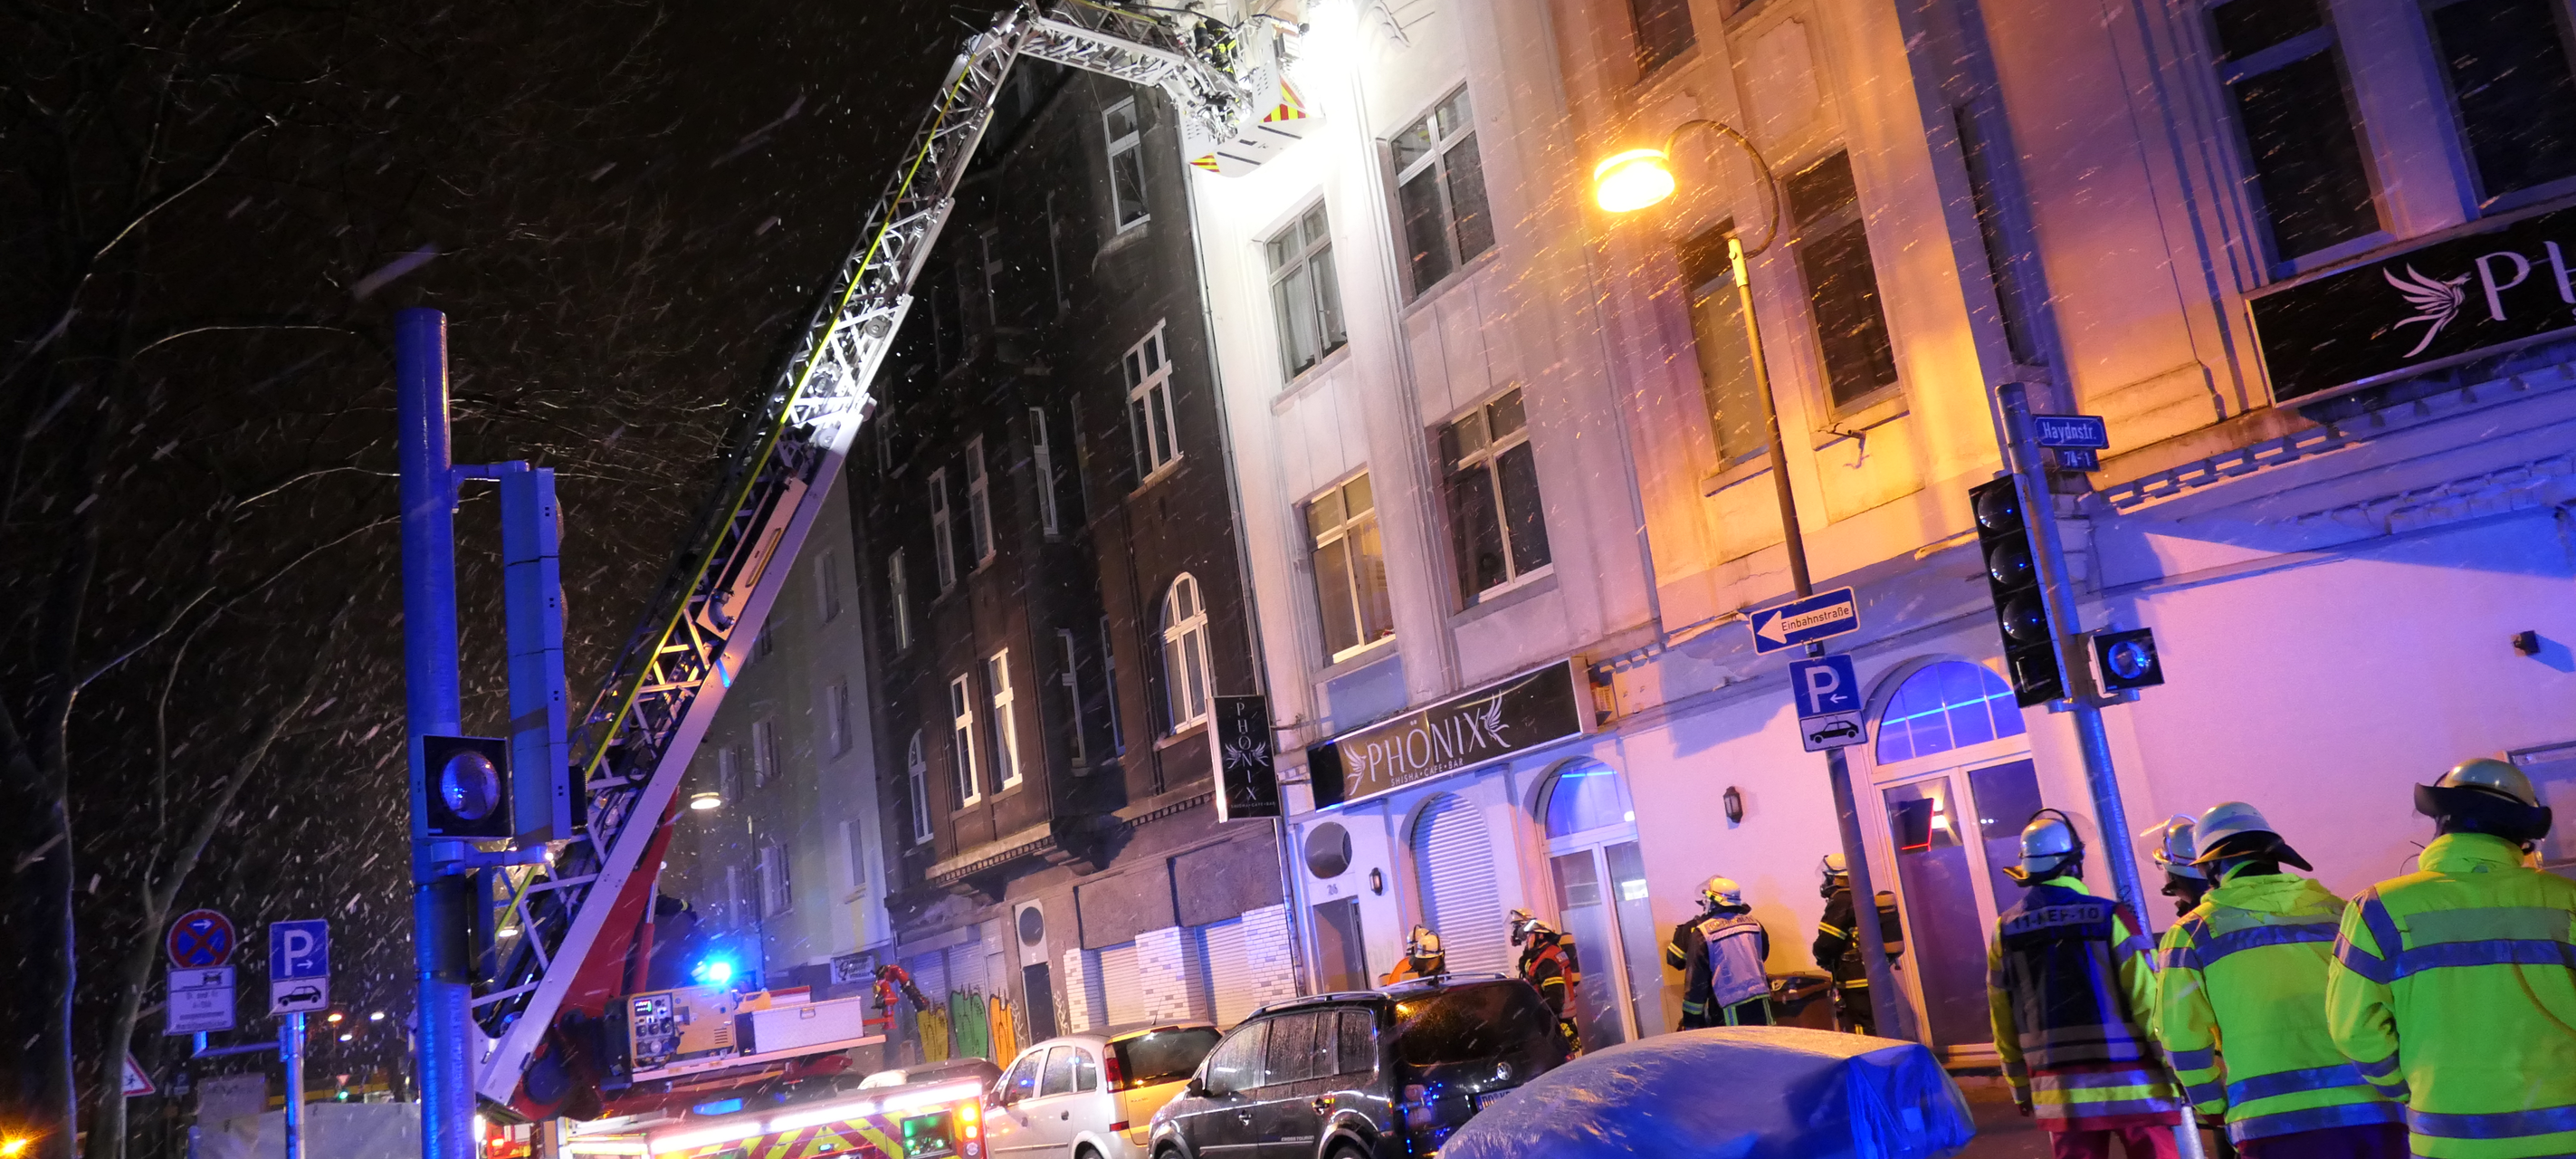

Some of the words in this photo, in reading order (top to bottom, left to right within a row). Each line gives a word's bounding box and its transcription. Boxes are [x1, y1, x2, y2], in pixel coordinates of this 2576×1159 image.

[2042, 422, 2097, 444] Haydnstr.
[1781, 606, 1850, 632] Einbahnstraße
[1805, 665, 1840, 714] P
[1367, 707, 1486, 782] PHÖNIX
[283, 929, 314, 976] P
